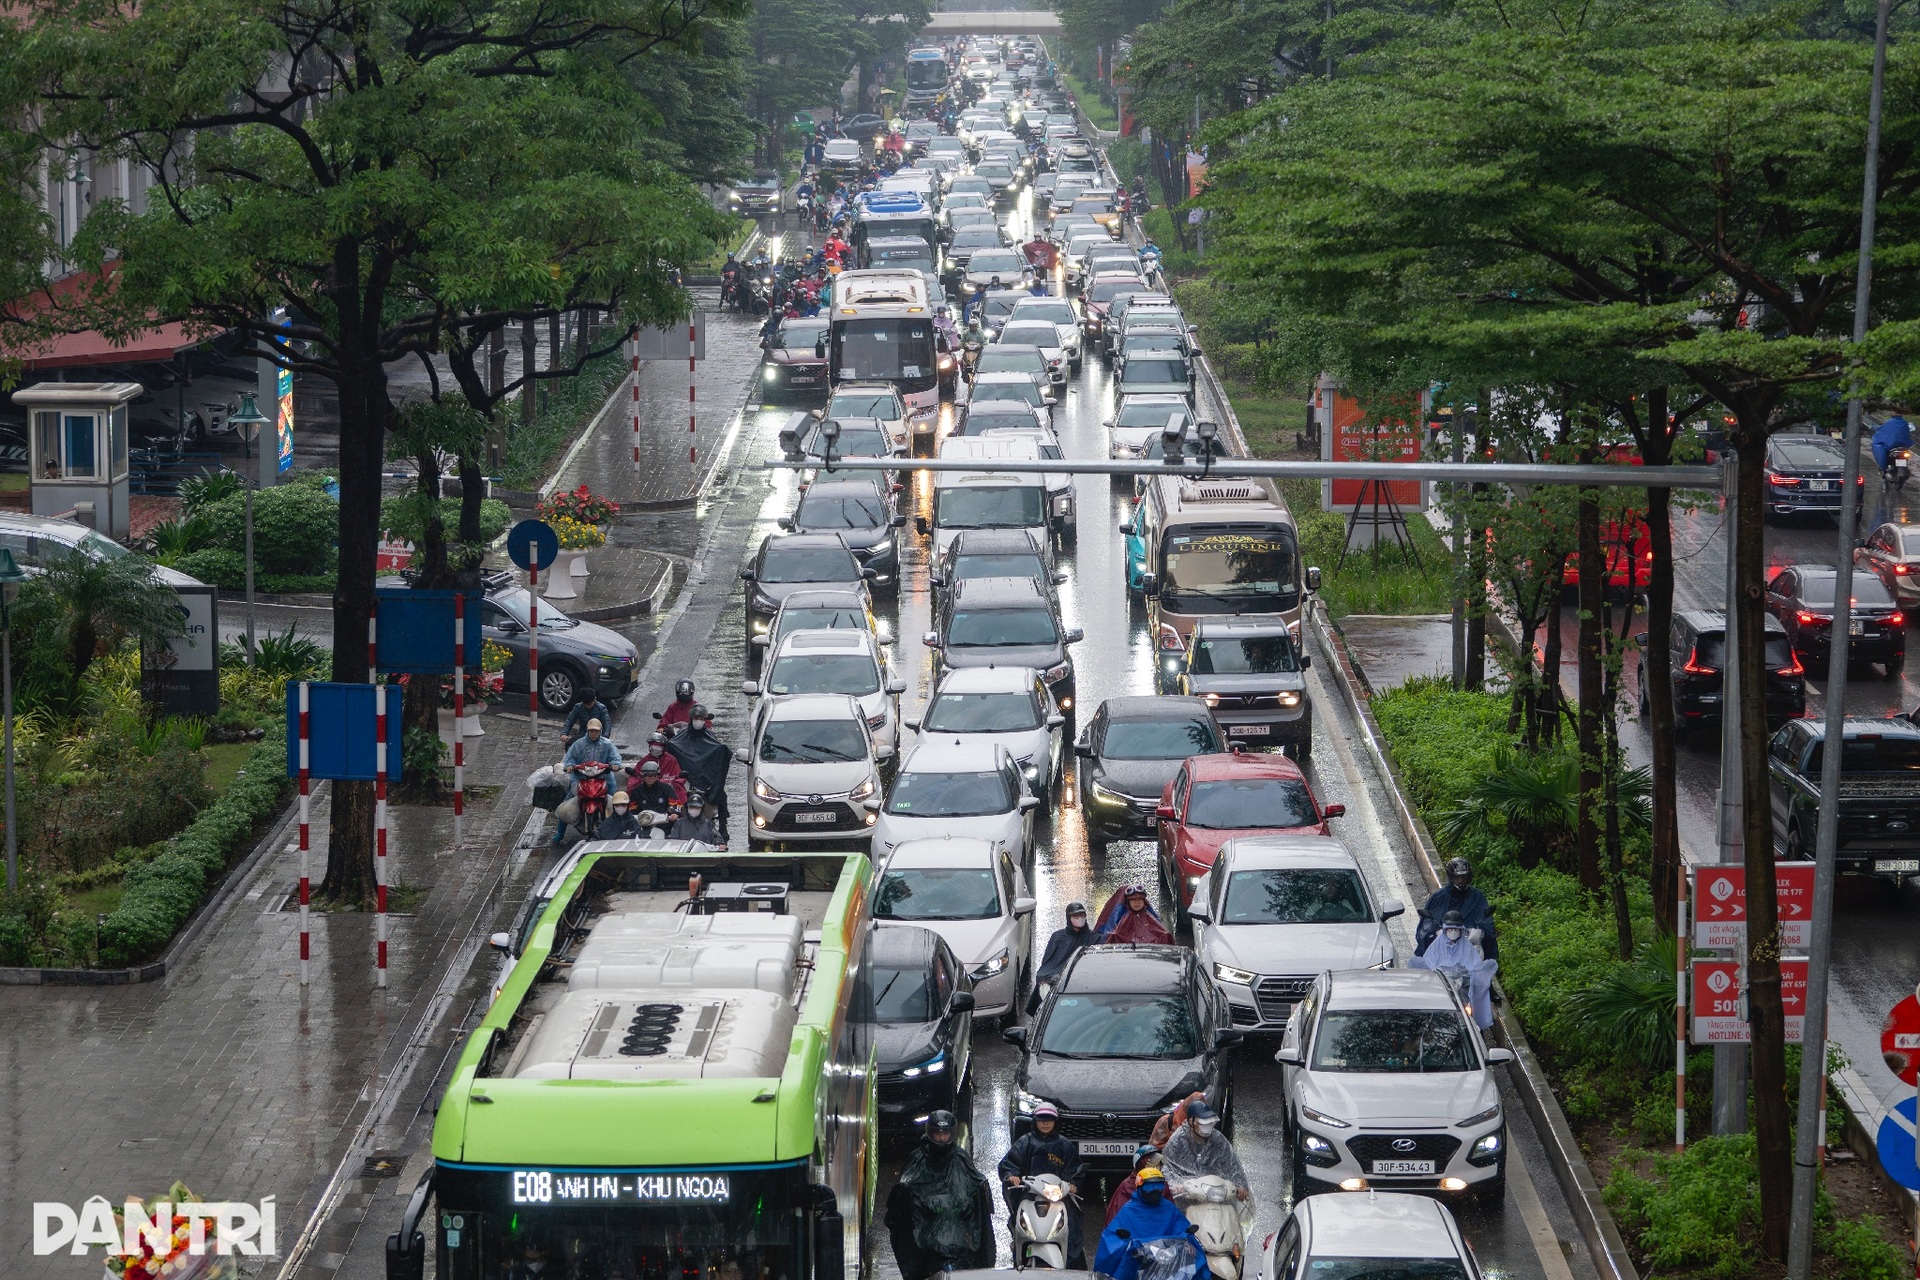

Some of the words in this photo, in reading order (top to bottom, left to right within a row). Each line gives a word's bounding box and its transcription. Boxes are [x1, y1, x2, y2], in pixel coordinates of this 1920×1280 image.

[1790, 888, 1803, 896] 17F
[1794, 980, 1807, 988] 65F
[514, 1171, 551, 1202] E08
[593, 1176, 618, 1199] HN
[637, 1176, 671, 1199] KHU
